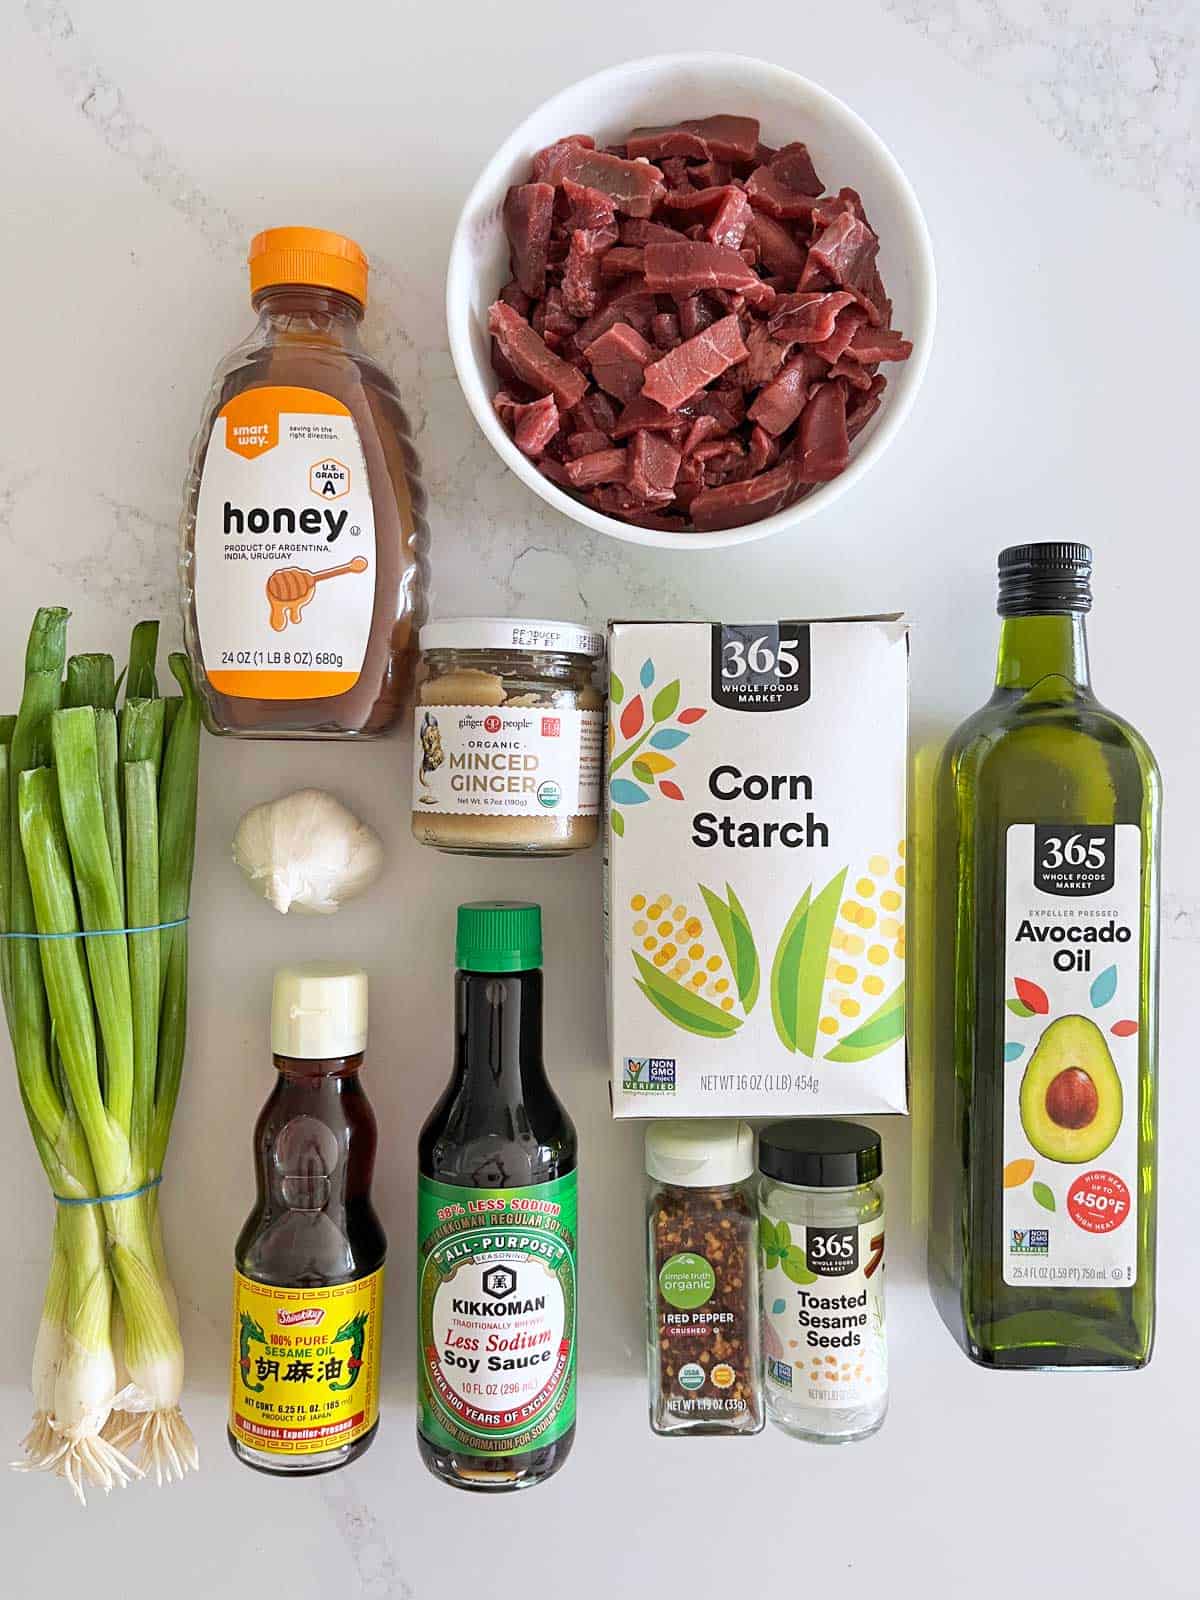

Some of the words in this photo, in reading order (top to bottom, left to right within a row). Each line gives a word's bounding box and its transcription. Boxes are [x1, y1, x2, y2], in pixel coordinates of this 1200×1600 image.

[233, 424, 269, 436] smart
[290, 432, 305, 440] right
[315, 472, 344, 480] GRADE
[322, 480, 336, 495] A
[224, 501, 348, 542] honey
[224, 544, 264, 552] PRODUCT
[265, 544, 277, 552] OF
[250, 552, 292, 560] URUGUAY
[222, 652, 234, 664] 24
[236, 652, 251, 664] OZ
[254, 651, 264, 666] (1
[268, 652, 280, 664] LB
[284, 652, 291, 664] 8
[294, 652, 313, 666] OZ)
[316, 652, 343, 668] 680g
[721, 636, 800, 678] 365
[722, 684, 760, 693] WHOLE
[763, 684, 800, 692] FOODS
[738, 694, 782, 703] MARKET
[458, 717, 484, 730] ginger
[502, 717, 530, 730] people
[468, 740, 520, 749] ORGANIC
[450, 752, 539, 771] MINCED
[451, 774, 537, 792] GINGER
[708, 765, 814, 801] Corn
[692, 812, 829, 848] Starch
[1042, 834, 1106, 870] 365
[1015, 920, 1132, 942] Avocado
[1053, 949, 1091, 972] Oil
[652, 1060, 673, 1068] NON
[651, 1068, 674, 1076] GMO
[625, 1082, 674, 1090] VERIFIED
[700, 1076, 718, 1091] NET
[720, 1076, 735, 1090] WT
[736, 1075, 747, 1090] 16
[750, 1075, 762, 1090] OZ
[764, 1075, 774, 1092] (1
[776, 1074, 792, 1092] LB)
[794, 1074, 820, 1093] 454g
[1086, 1174, 1106, 1184] HIGH
[1073, 1190, 1126, 1214] 450°F
[437, 1203, 466, 1221] 38%
[468, 1199, 505, 1213] LESS
[511, 1199, 560, 1216] SODIUM
[491, 1214, 542, 1226] REGULAR
[446, 1236, 556, 1262] ALL-PURPOSE
[812, 1234, 854, 1258] 365
[476, 1252, 527, 1262] SEASONING
[664, 1272, 690, 1282] simple
[690, 1272, 710, 1280] truth
[1012, 1267, 1028, 1279] 25.4
[1030, 1267, 1038, 1278] FL
[1039, 1267, 1048, 1278] OZ
[1068, 1268, 1080, 1280] PT)
[1082, 1268, 1096, 1279] 750
[664, 1280, 710, 1292] organic
[452, 1296, 546, 1316] KIKKOMAN
[798, 1290, 868, 1310] Toasted
[452, 1318, 512, 1330] TRADITIONALLY
[514, 1318, 543, 1328] BREW
[668, 1314, 690, 1324] RED
[692, 1312, 734, 1323] PEPPER
[798, 1310, 868, 1330] Sesame
[270, 1334, 292, 1346] 100%
[296, 1334, 329, 1346] PURE
[444, 1328, 480, 1351] Less
[485, 1329, 552, 1352] Sodium
[806, 1330, 861, 1348] Seeds
[264, 1346, 312, 1358] SESAME
[316, 1346, 335, 1356] OIL
[444, 1350, 480, 1373] Soy
[488, 1350, 552, 1371] Sauce
[254, 1356, 344, 1383] 胡麻油
[430, 1361, 448, 1393] OVER
[446, 1391, 464, 1410] 300
[466, 1406, 500, 1425] YEARS
[504, 1412, 518, 1423] OF
[462, 1382, 472, 1392] 10
[474, 1383, 484, 1394] FL
[486, 1384, 498, 1395] OZ
[500, 1384, 519, 1395] (296
[278, 1405, 295, 1414] 6.25
[668, 1400, 680, 1410] NET
[683, 1400, 695, 1410] WT
[713, 1400, 723, 1410] OZ
[262, 1412, 294, 1422] PRODUCT
[310, 1412, 332, 1421] JAPAN
[242, 1420, 251, 1430] All
[283, 1418, 352, 1440] Expeller-Pressed
[458, 1430, 513, 1450] INFORMATION
[514, 1432, 531, 1448] FOR
[531, 1410, 557, 1438] SODIUM
